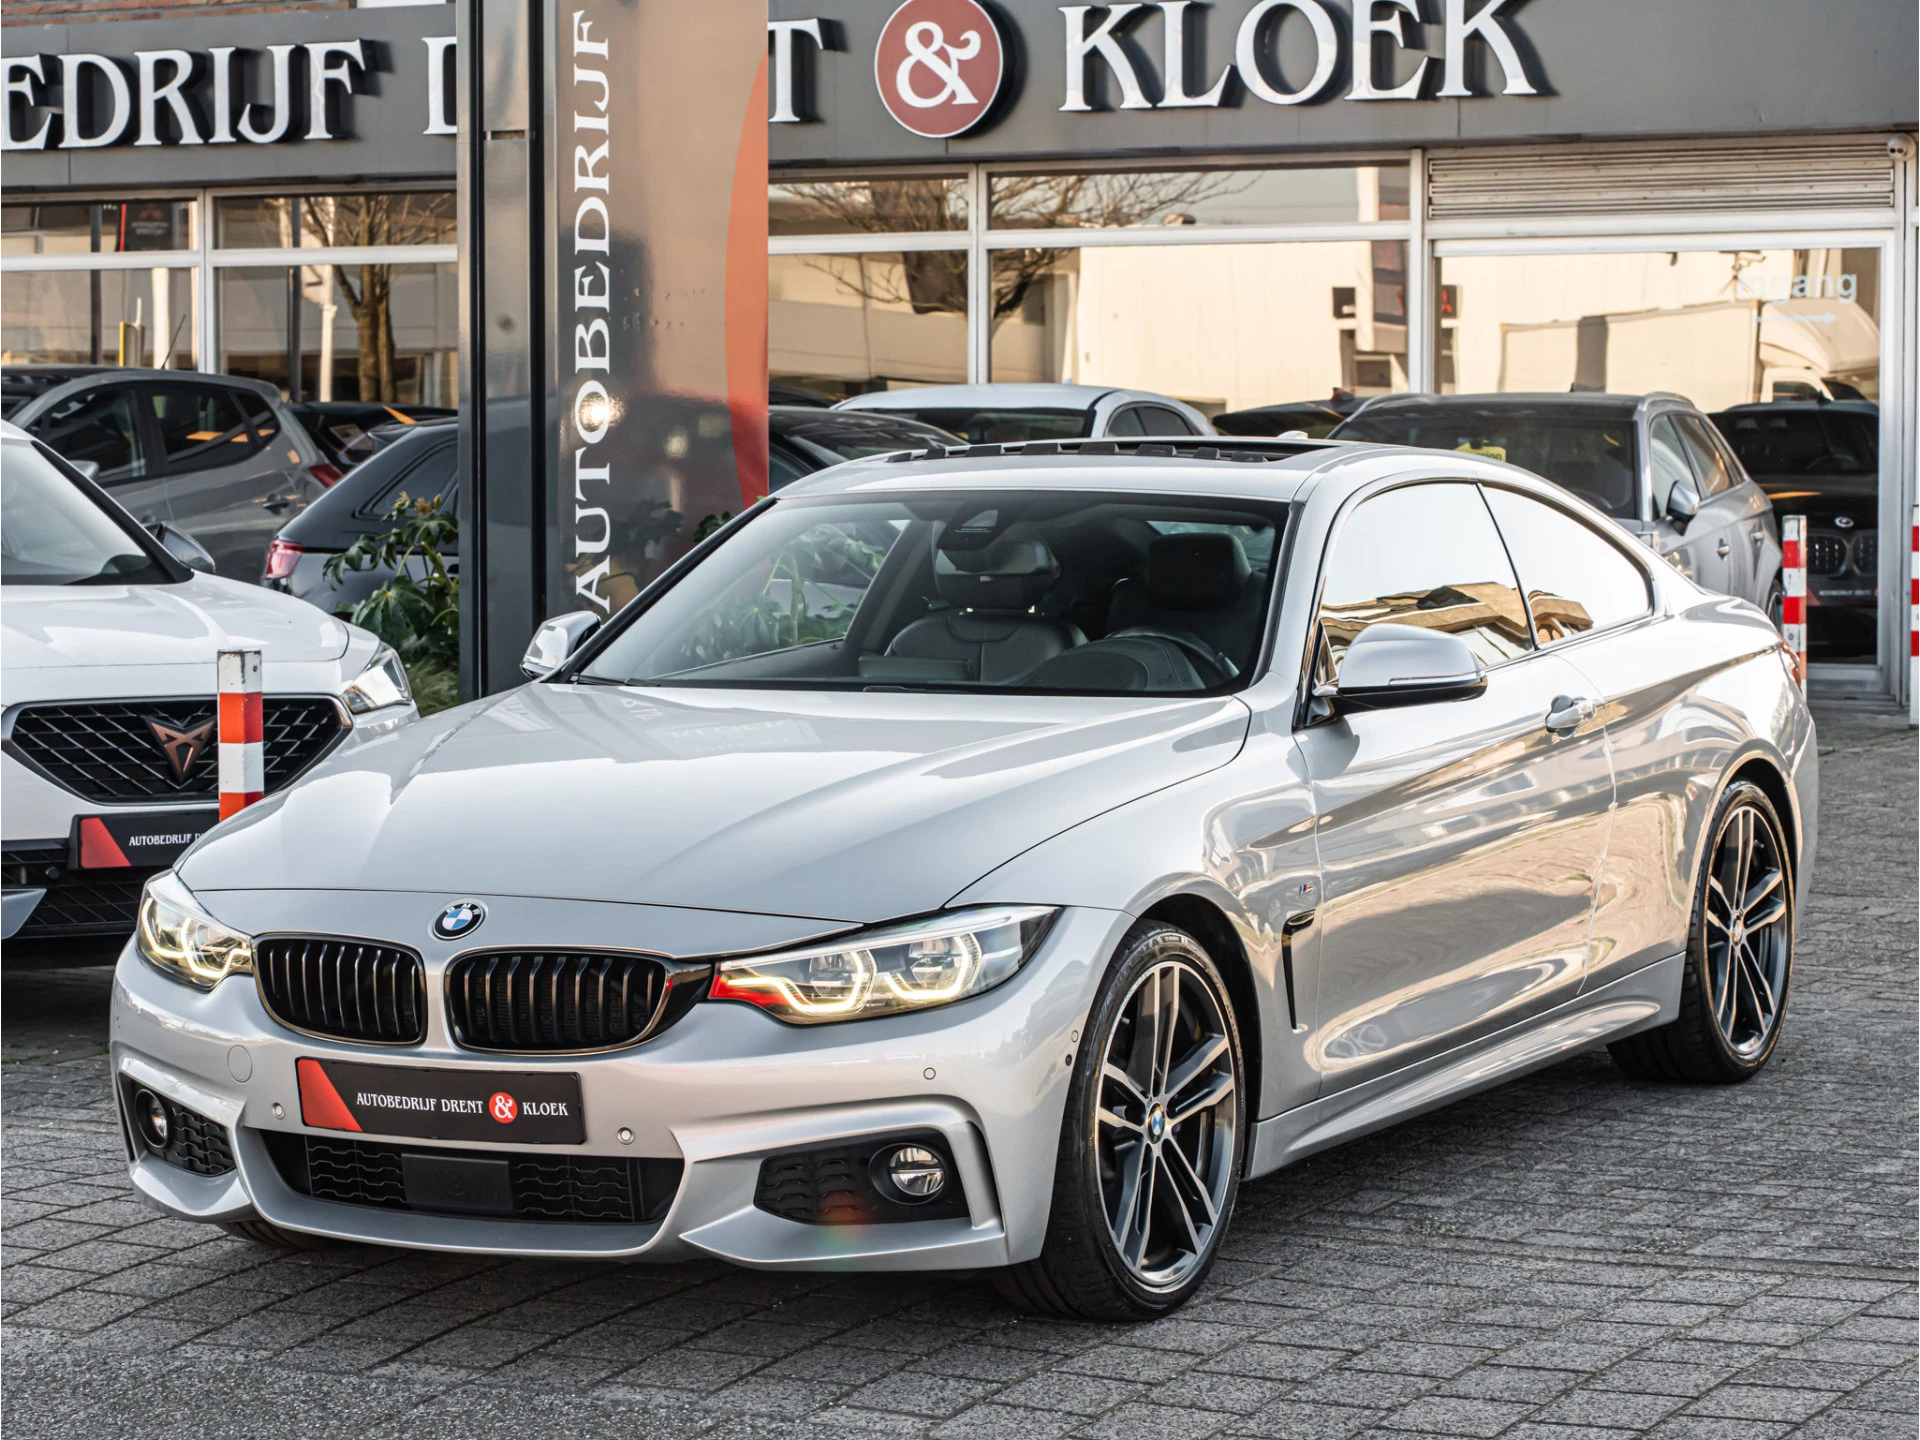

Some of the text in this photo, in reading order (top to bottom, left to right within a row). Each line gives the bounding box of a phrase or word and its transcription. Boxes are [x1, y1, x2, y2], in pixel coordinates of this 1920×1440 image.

[896, 21, 981, 108] &
[1058, 0, 1537, 111] KLOEK
[572, 9, 611, 614] AUTOBEDRIJF
[128, 833, 192, 847] AUTOBEDRIJF
[356, 1092, 569, 1119] AUTOBEDRIJF DRENT & KLOEK
